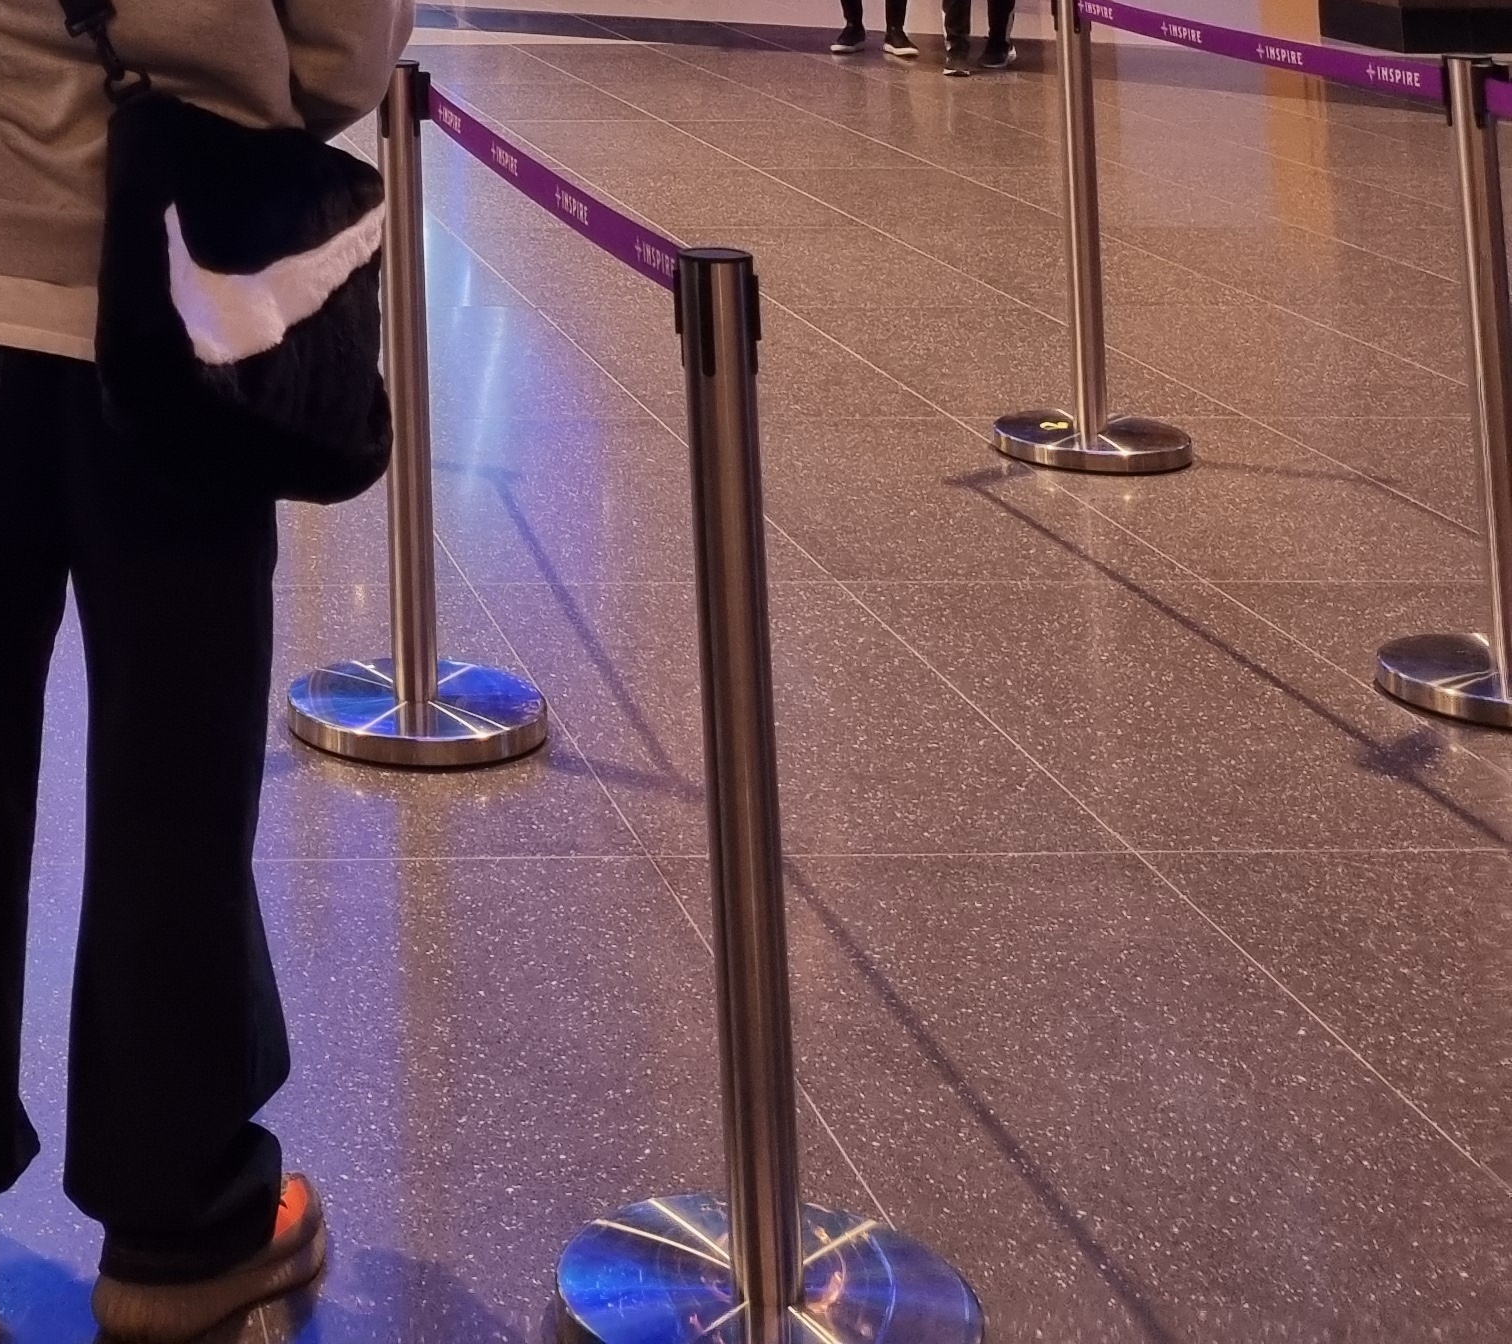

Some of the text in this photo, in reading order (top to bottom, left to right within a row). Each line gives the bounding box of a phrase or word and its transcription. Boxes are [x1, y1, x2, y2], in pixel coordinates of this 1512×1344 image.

[1084, 1, 1114, 21] INSPIRE
[1168, 23, 1203, 45] INSPIRE
[1265, 45, 1303, 66] INSPIRE
[1376, 65, 1421, 88] INSPIRE
[560, 189, 589, 226] INSPIRE
